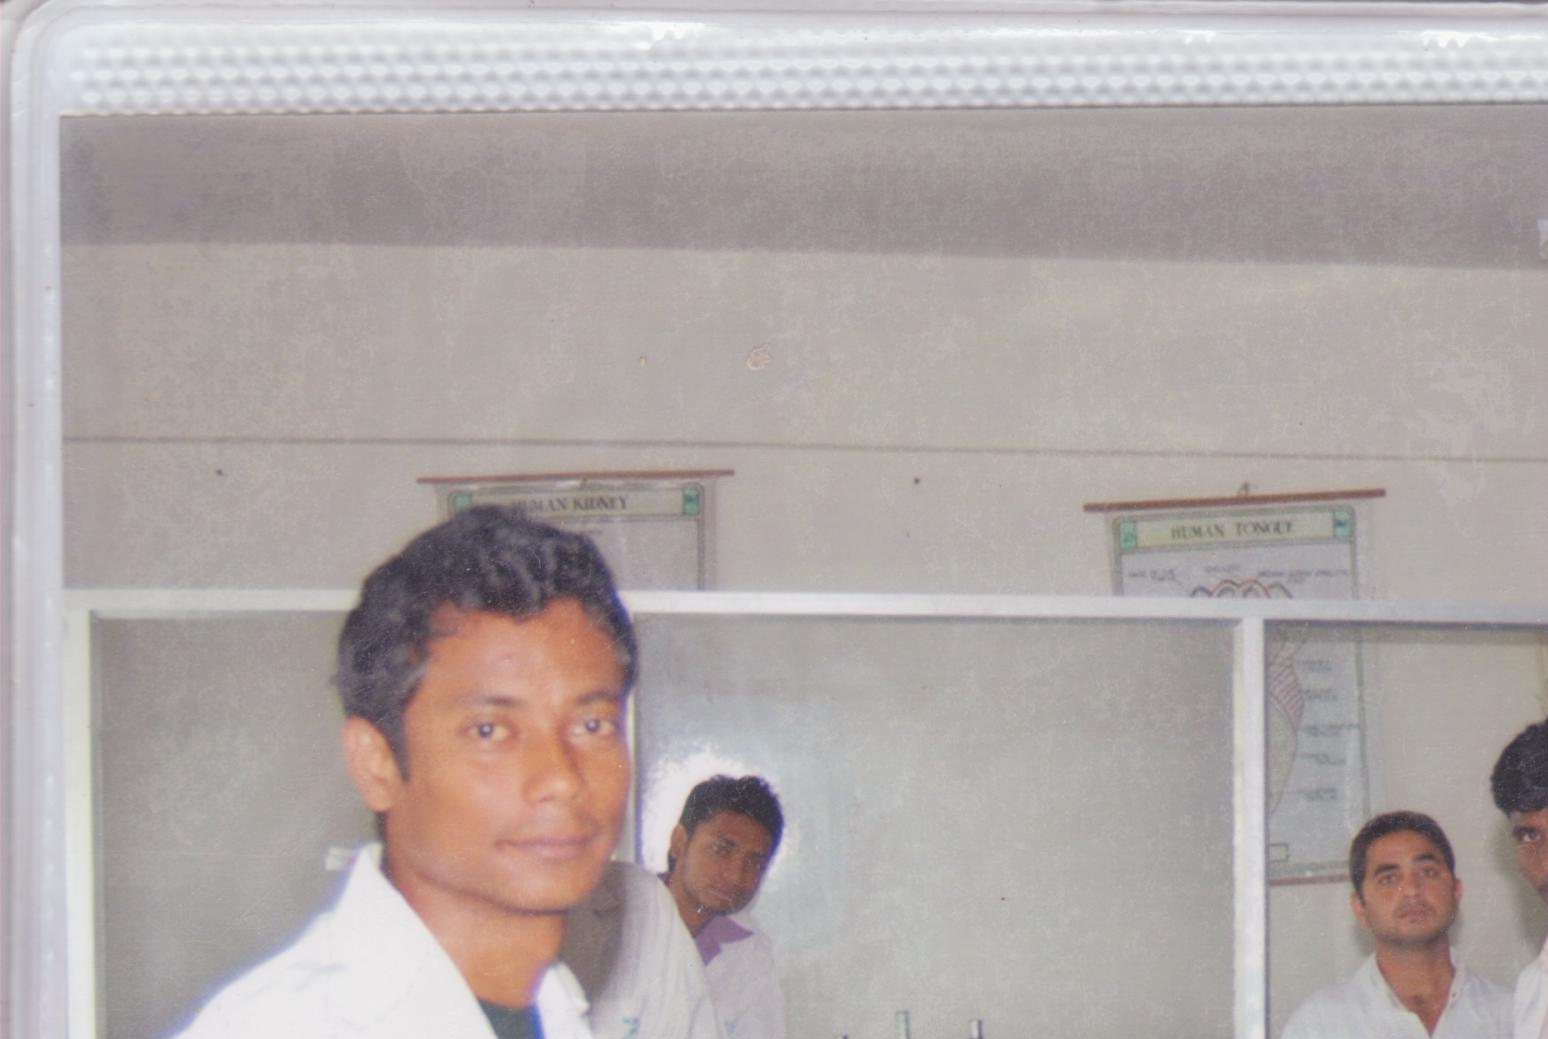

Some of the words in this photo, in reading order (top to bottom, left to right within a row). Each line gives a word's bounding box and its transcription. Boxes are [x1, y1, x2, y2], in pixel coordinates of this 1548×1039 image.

[572, 495, 629, 511] KIDNEY
[1170, 525, 1226, 541] HUMAN
[1234, 520, 1294, 538] TONGUE
